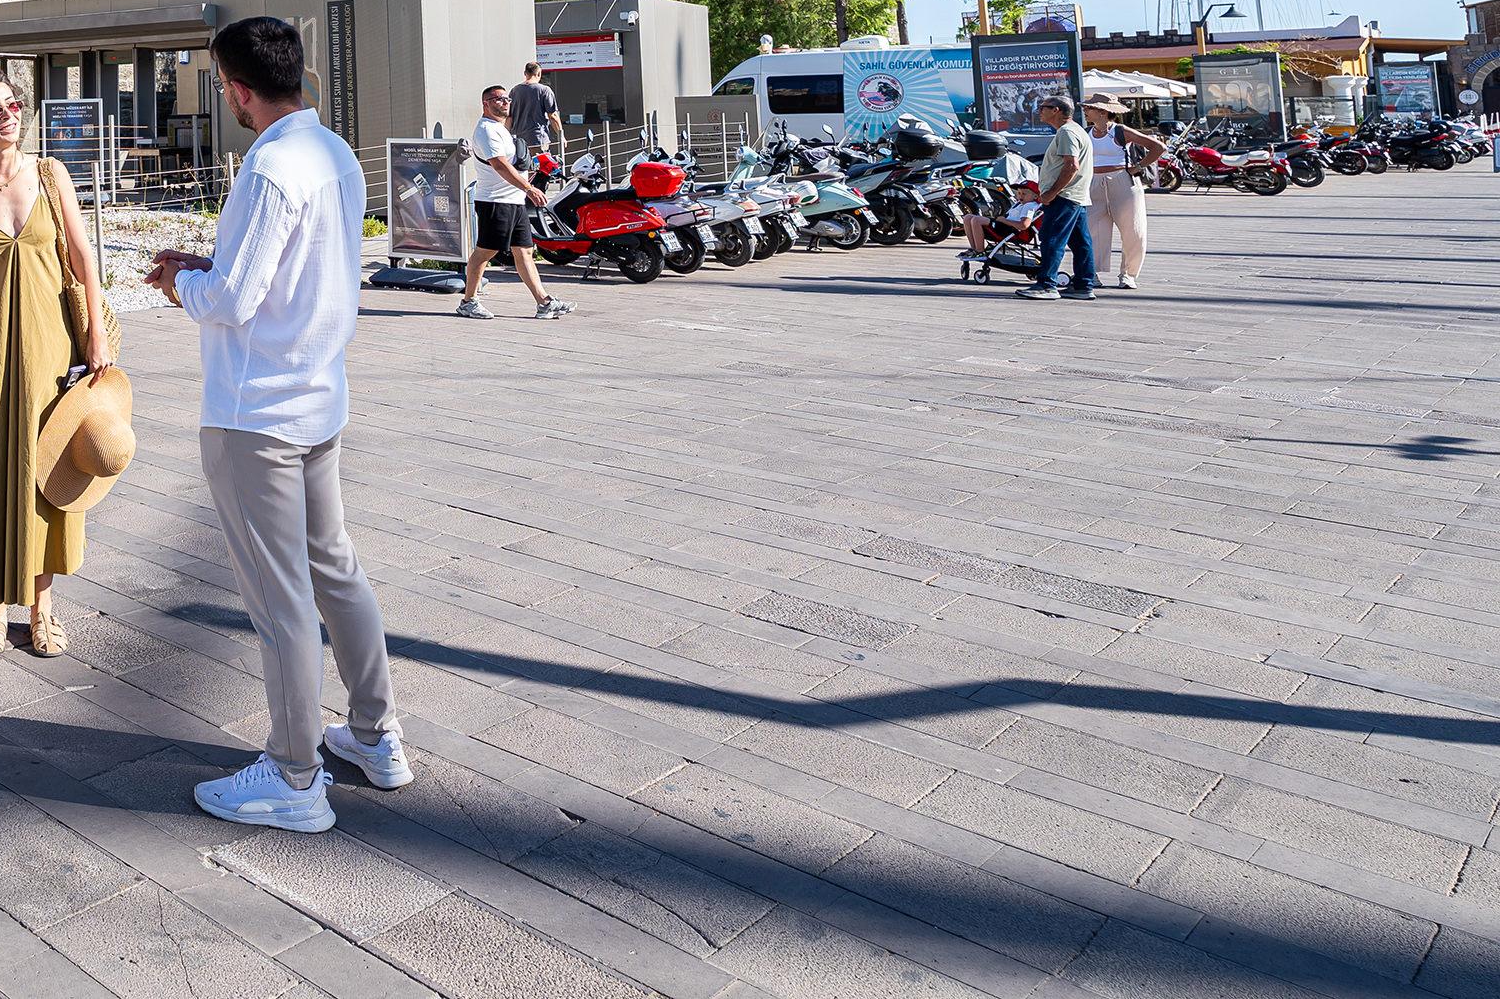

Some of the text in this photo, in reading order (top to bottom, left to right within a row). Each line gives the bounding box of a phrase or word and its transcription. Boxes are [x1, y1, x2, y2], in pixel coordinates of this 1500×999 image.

[330, 5, 339, 32] MÜZESİ
[344, 4, 352, 48] ARCHAEOLOGY
[331, 33, 341, 70] ARKEOLOJİ
[860, 60, 886, 70] SAHİL
[888, 58, 934, 70] GÜVENLİK
[346, 48, 354, 90] UNDERWATER
[985, 62, 1068, 72] BİZ DEĞİŞTİRİYORUZ.
[347, 91, 354, 100] OF
[332, 97, 342, 121] KALESİ
